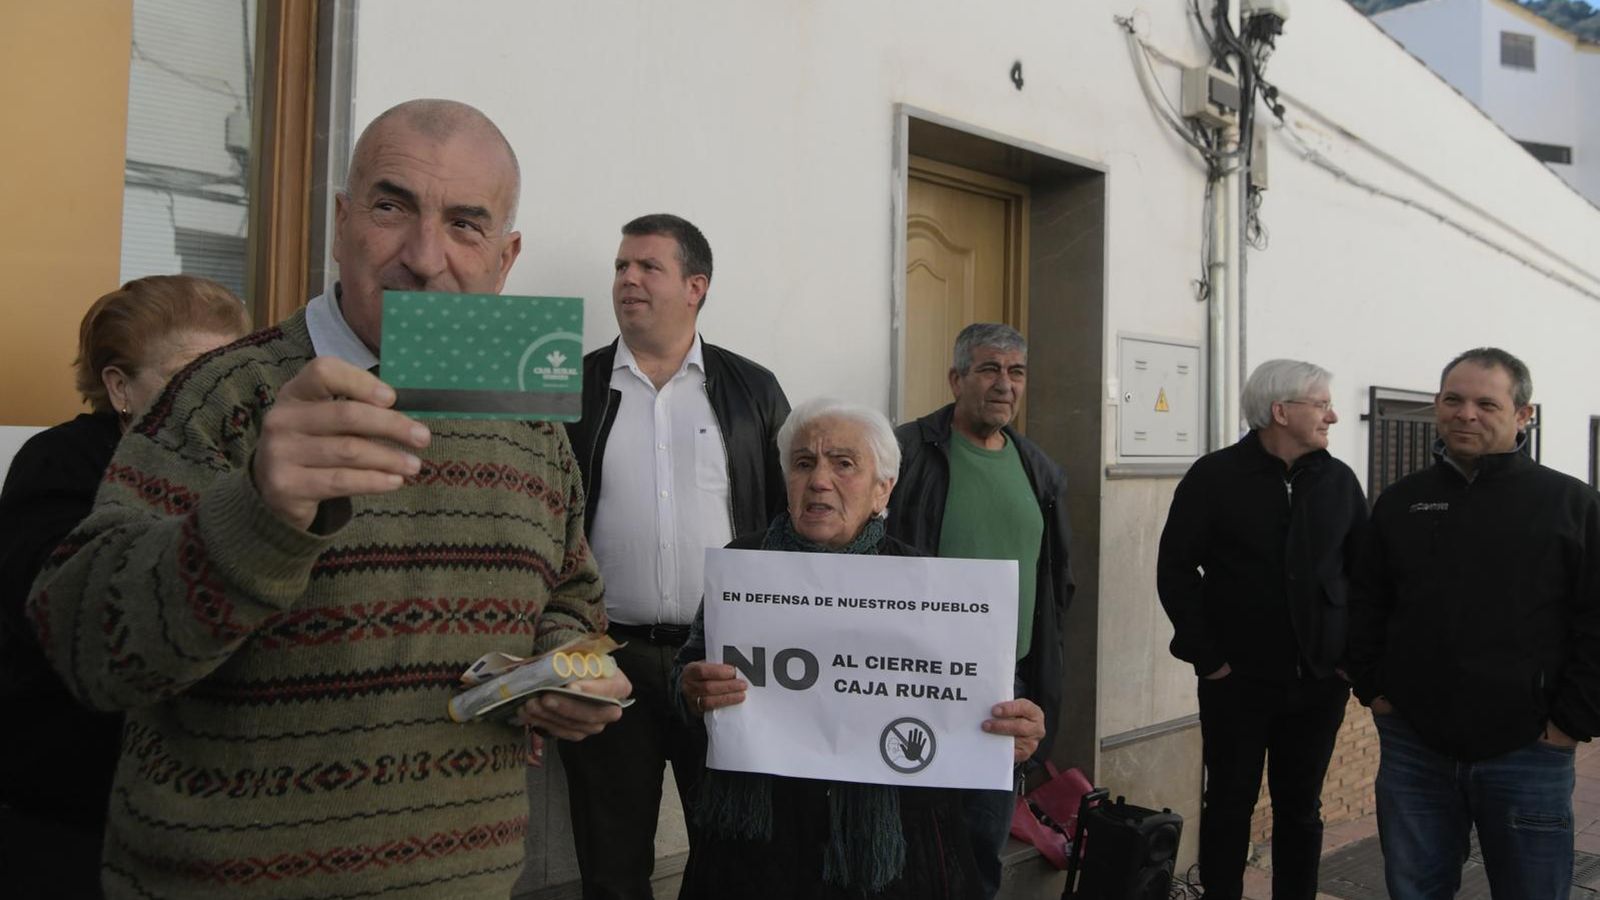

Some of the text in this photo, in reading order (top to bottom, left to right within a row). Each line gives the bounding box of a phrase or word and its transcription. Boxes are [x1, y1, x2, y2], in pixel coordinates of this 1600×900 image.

[722, 591, 990, 614] EN DEFENSA DE NUESTROS PUEBLOS
[722, 645, 820, 691] NO
[831, 654, 978, 677] AL CIERRE DE
[833, 679, 968, 701] CAJA RURAL
